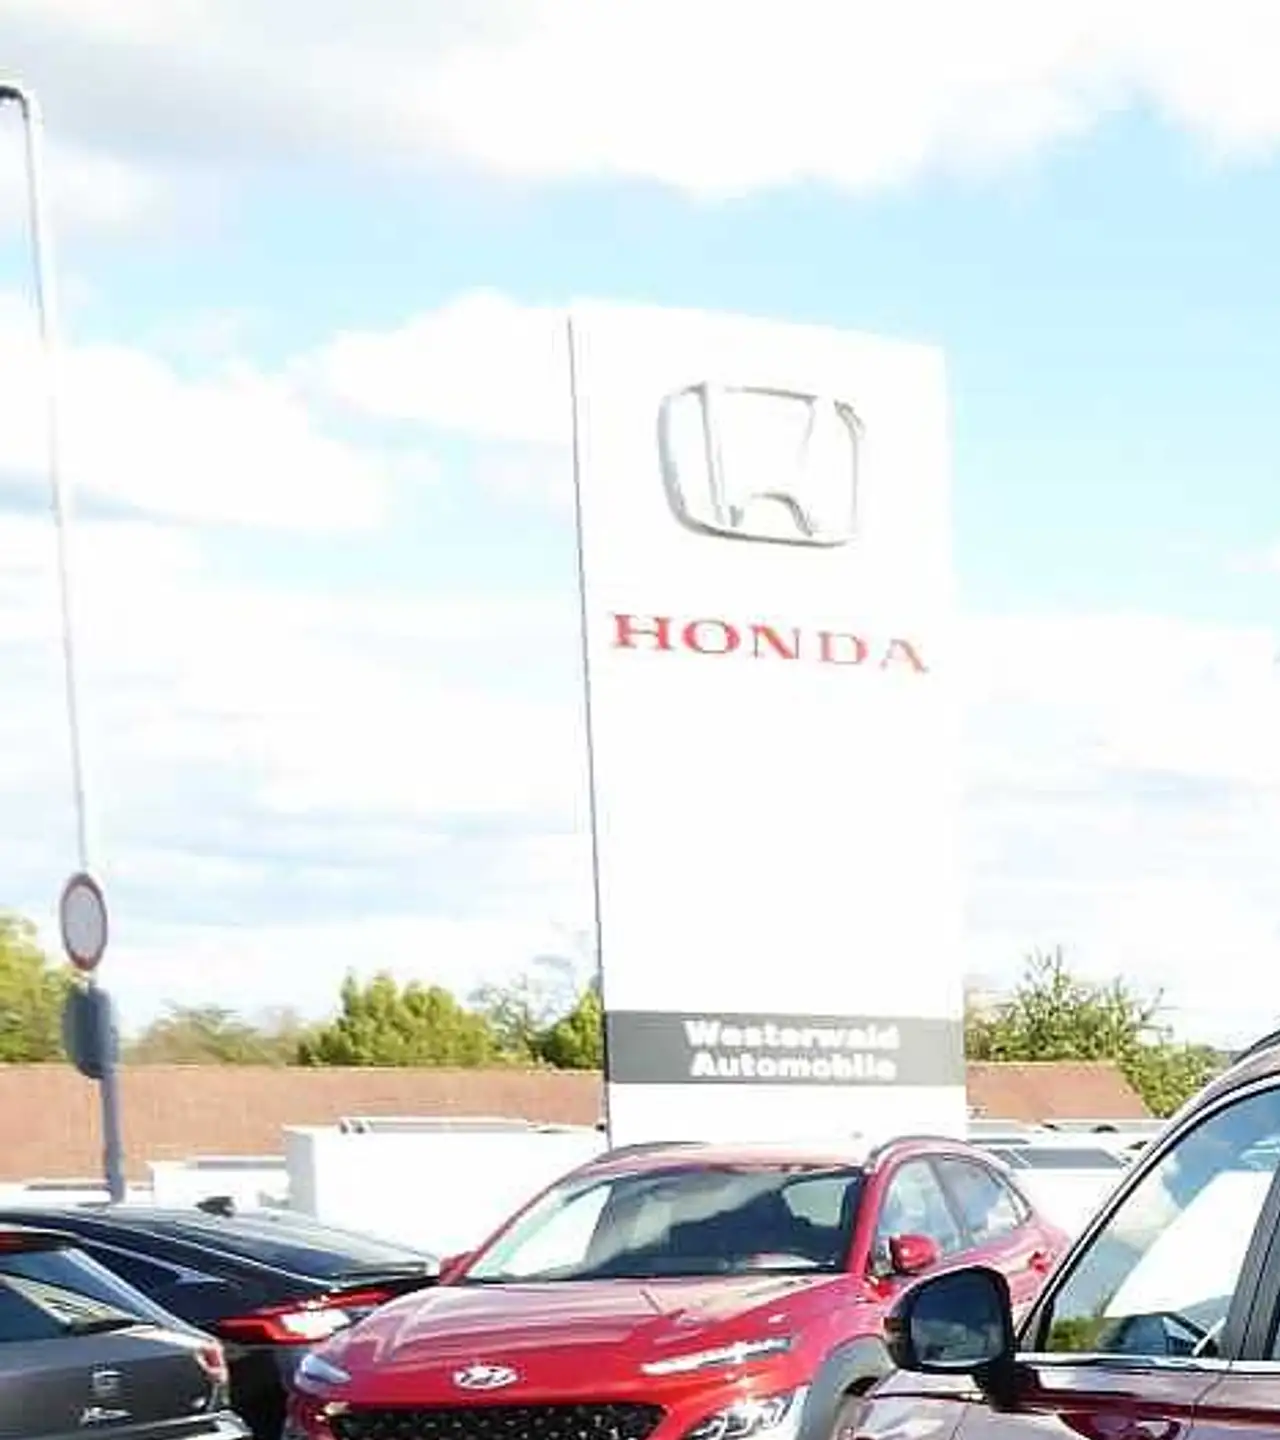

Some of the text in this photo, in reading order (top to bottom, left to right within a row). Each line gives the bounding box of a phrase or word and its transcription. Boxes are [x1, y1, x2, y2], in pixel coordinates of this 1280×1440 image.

[610, 612, 930, 674] HONDA
[683, 1019, 899, 1049] Westerwald
[690, 1052, 897, 1081] Automobile
